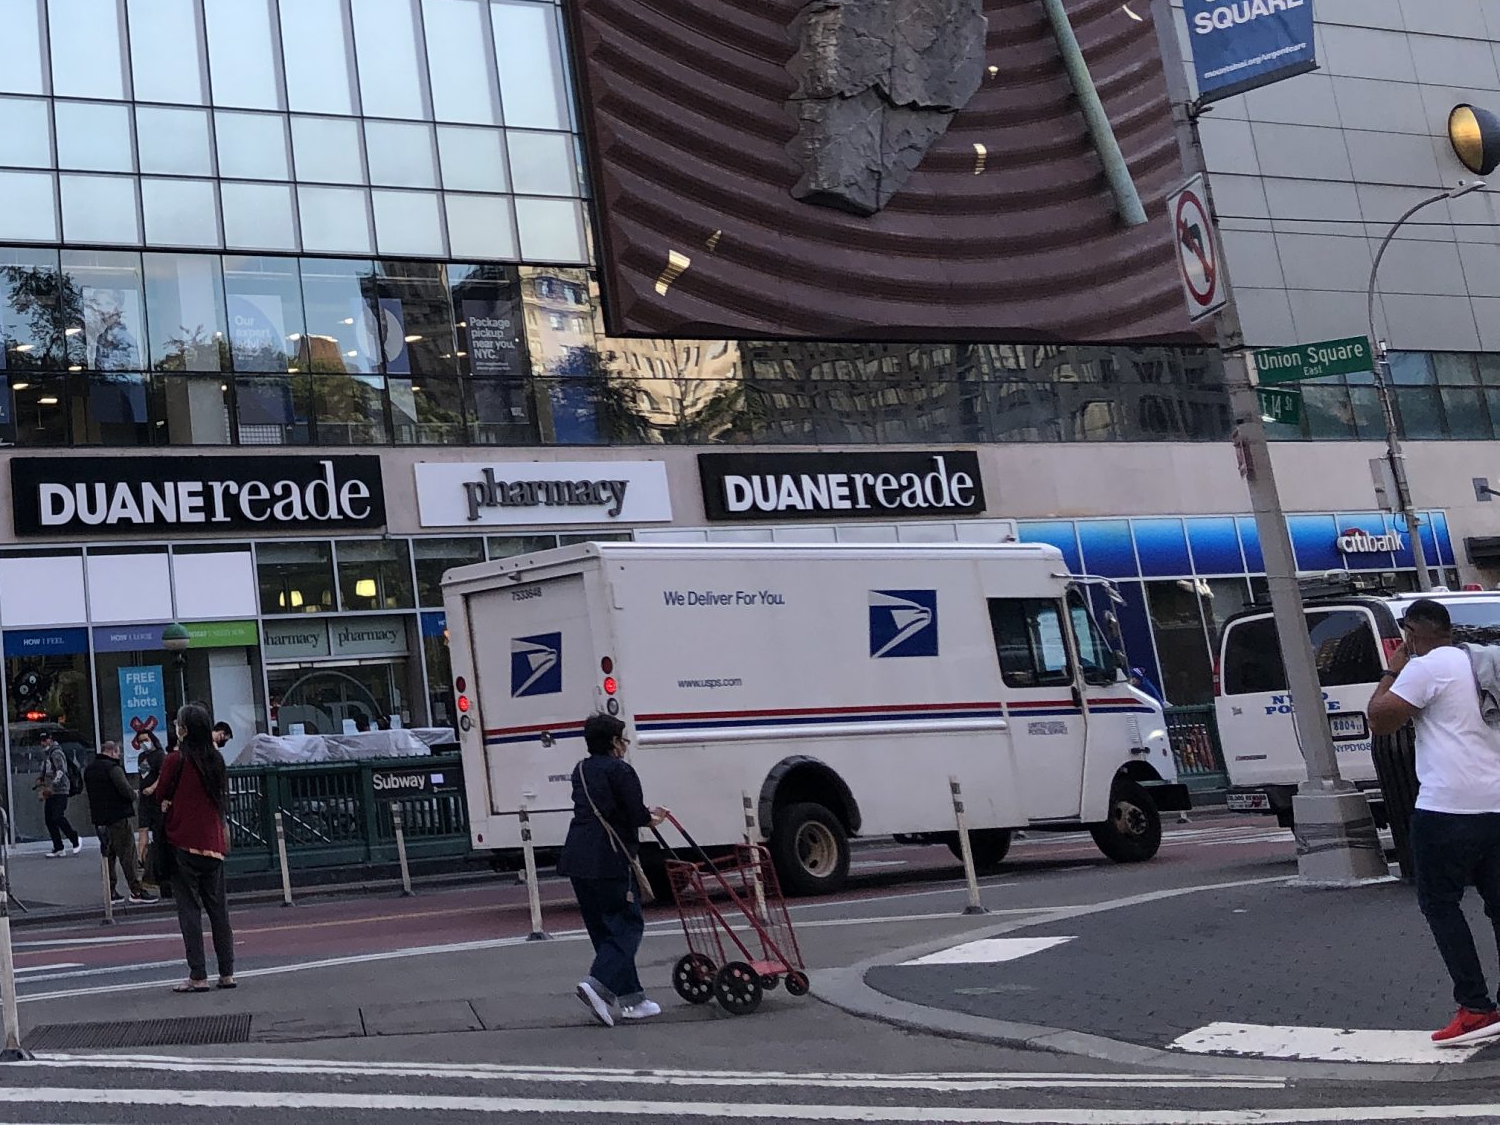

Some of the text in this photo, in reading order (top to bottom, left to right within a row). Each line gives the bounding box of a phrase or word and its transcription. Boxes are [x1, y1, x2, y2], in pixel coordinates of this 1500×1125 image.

[235, 315, 254, 325] Our
[470, 317, 510, 329] Package
[471, 328, 504, 339] pickup
[473, 339, 493, 348] near
[1258, 341, 1364, 370] Union Square
[1303, 365, 1322, 375] East
[1262, 394, 1267, 408] E
[1271, 395, 1281, 418] 14
[463, 467, 629, 521] pharmacy
[1341, 529, 1405, 553] citibank
[664, 590, 785, 606] We Deliver For You.
[23, 638, 40, 646] HOW
[338, 627, 398, 647] pharmacy
[126, 672, 155, 683] FREE
[677, 677, 742, 688] www.usps.com
[134, 685, 148, 695] flu
[127, 697, 157, 708] shots
[1264, 701, 1341, 715] POE
[373, 774, 425, 790] Subway
